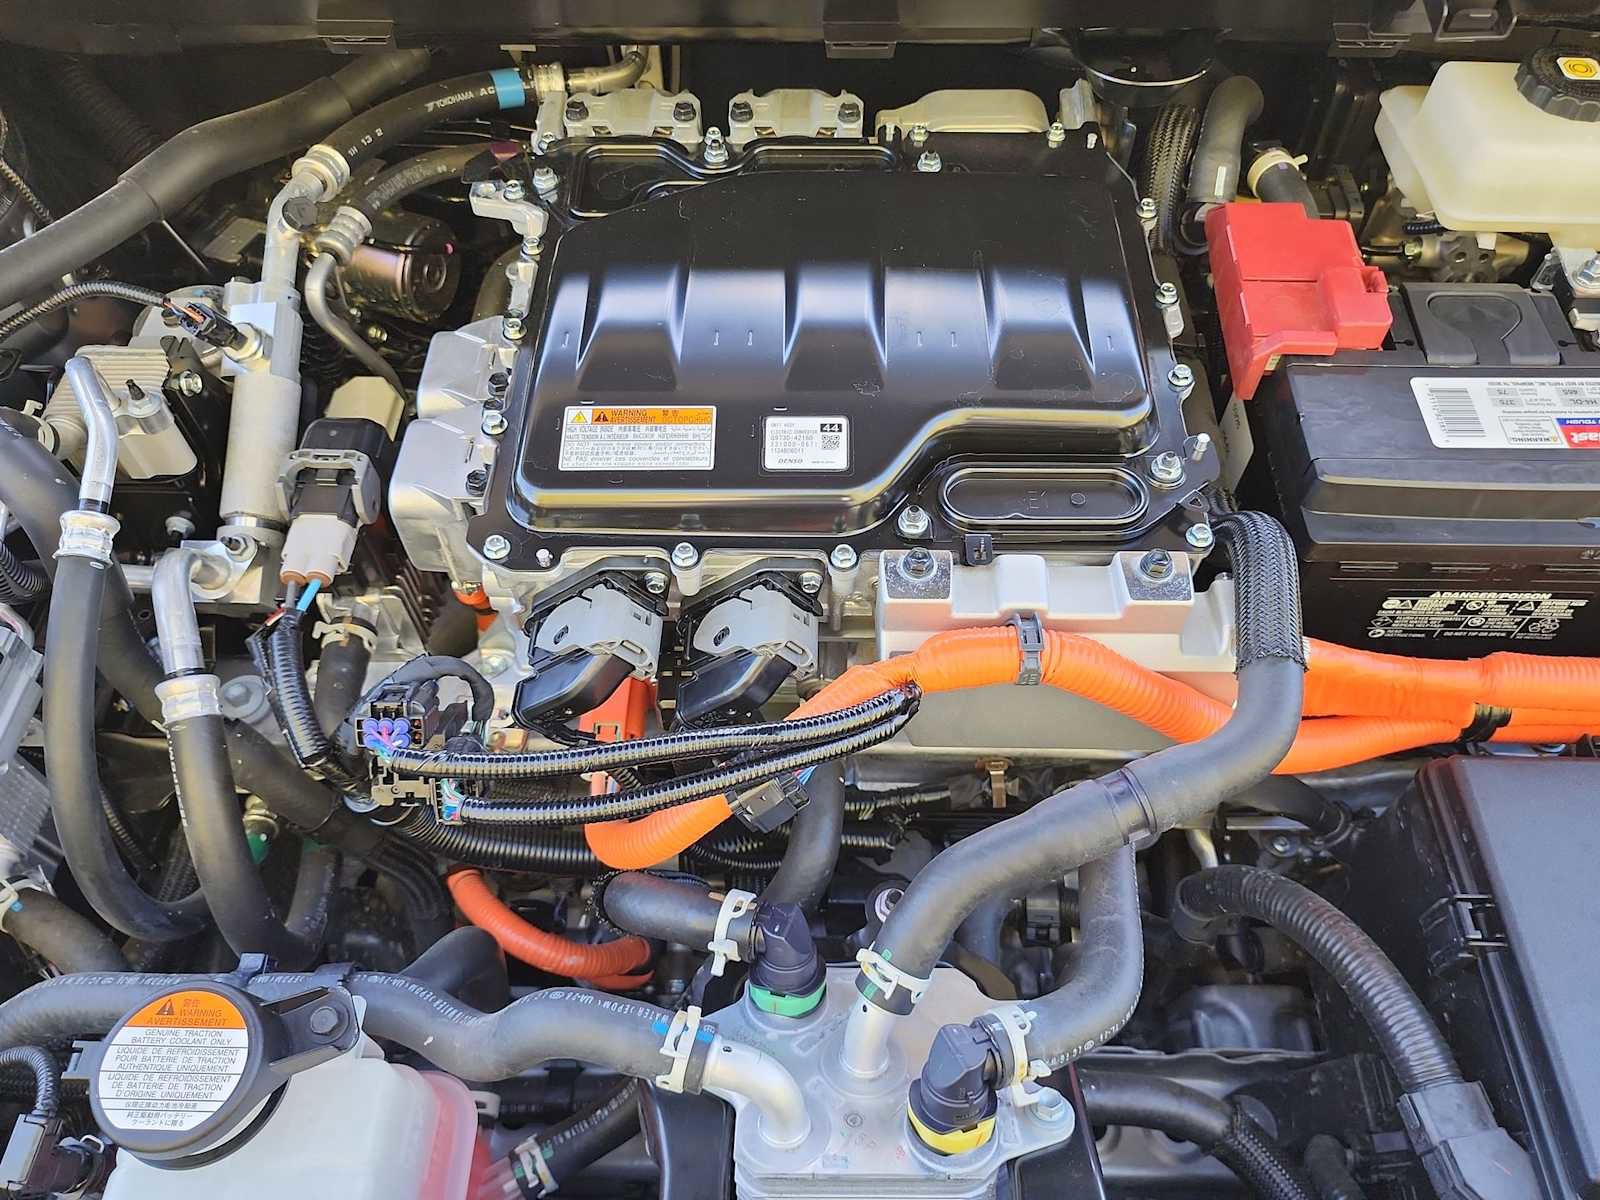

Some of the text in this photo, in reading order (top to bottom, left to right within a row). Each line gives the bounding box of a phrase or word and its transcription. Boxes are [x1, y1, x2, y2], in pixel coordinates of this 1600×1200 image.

[822, 424, 840, 432] 44
[179, 1008, 222, 1018] WARNING
[146, 1017, 228, 1026] AVERTISSEMENT
[210, 1038, 232, 1046] ONLY
[166, 1048, 240, 1057] REFROIDISSEMENT
[141, 1055, 176, 1063] BATTERIE
[182, 1056, 192, 1064] DE
[198, 1056, 236, 1064] TRACTION
[117, 1063, 229, 1072] AUTHENTIQUE UNIQUEMENT
[158, 1075, 232, 1083] REFROIDISSEMENT
[168, 1082, 180, 1090] DE
